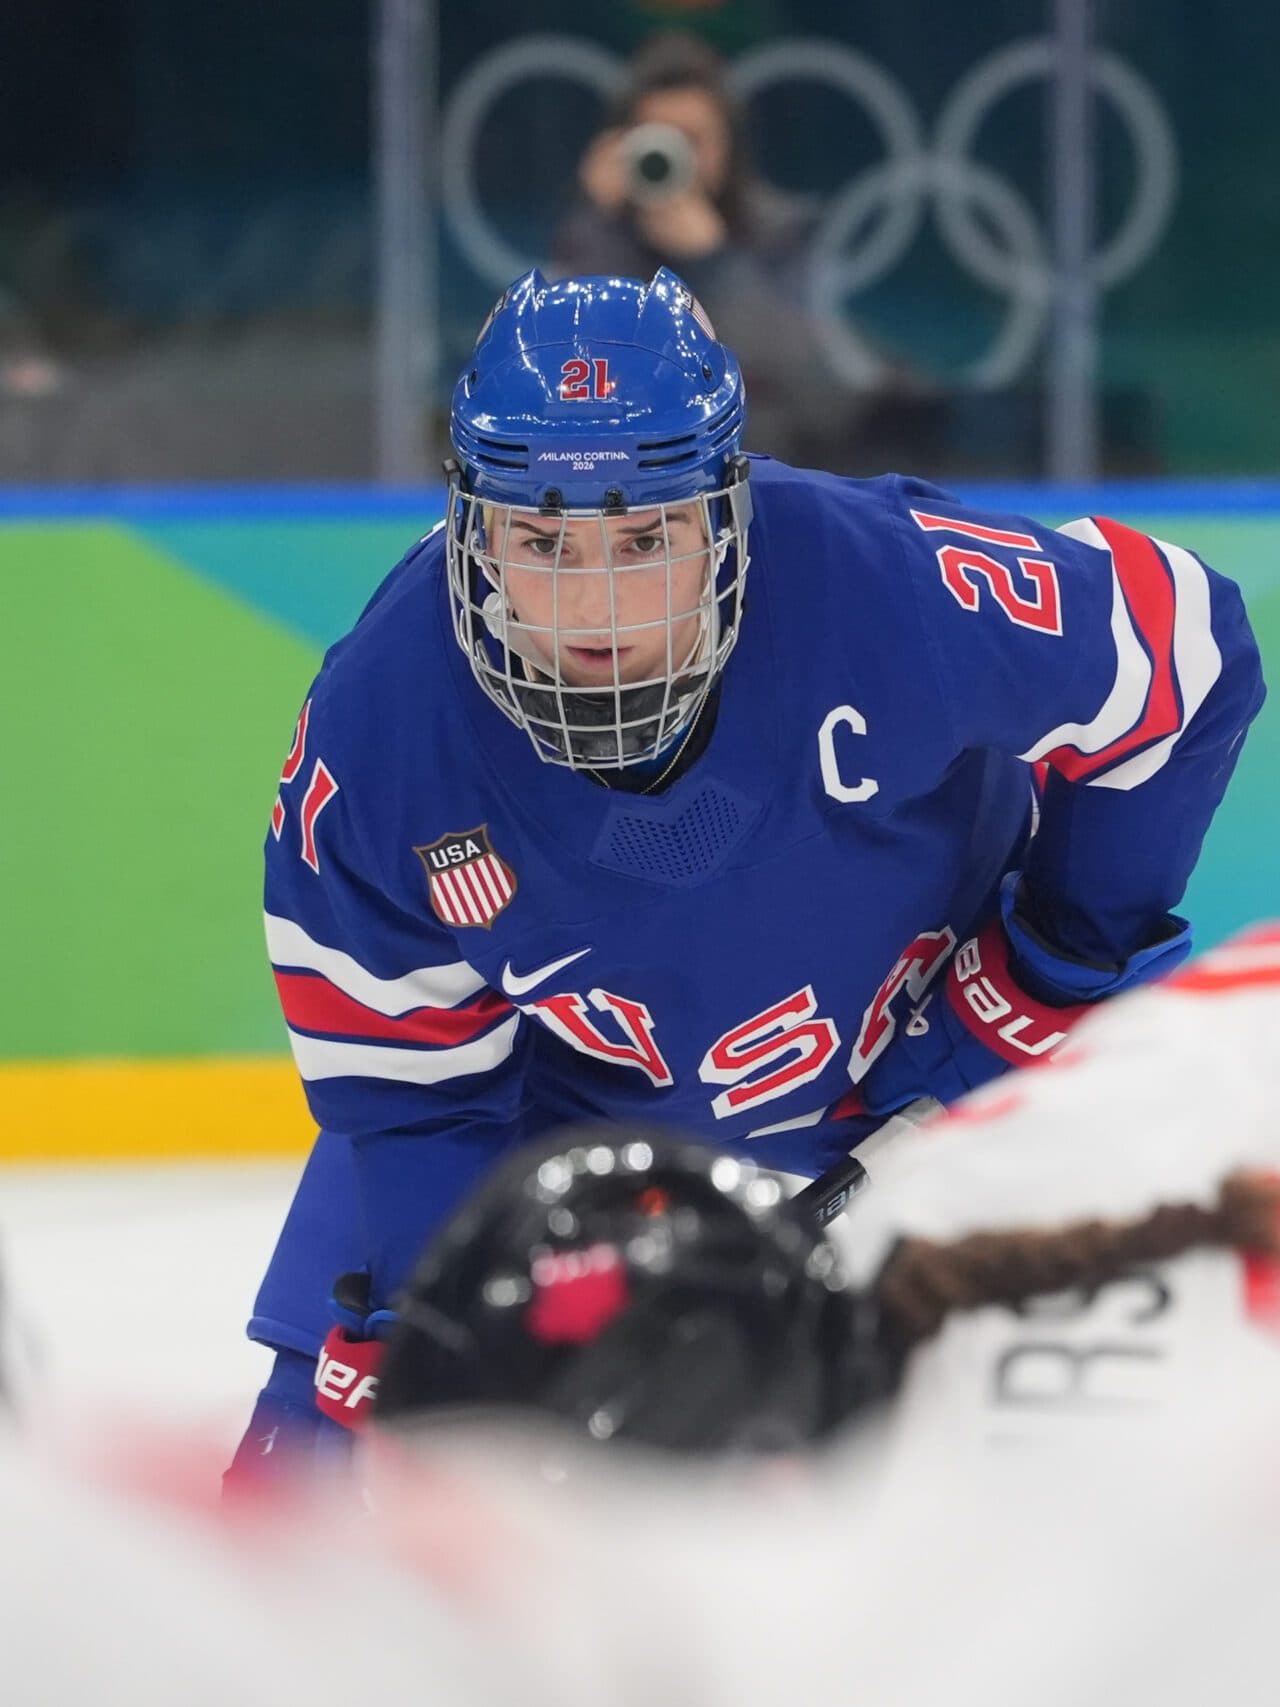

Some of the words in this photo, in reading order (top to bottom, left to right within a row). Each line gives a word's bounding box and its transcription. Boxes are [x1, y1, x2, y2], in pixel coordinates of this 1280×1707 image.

[561, 358, 608, 400] 21
[538, 452, 582, 461] MILANO
[584, 451, 630, 461] CORTINA
[573, 462, 595, 471] 2026
[910, 509, 1064, 637] 21
[818, 705, 879, 803] C
[429, 838, 481, 869] USA
